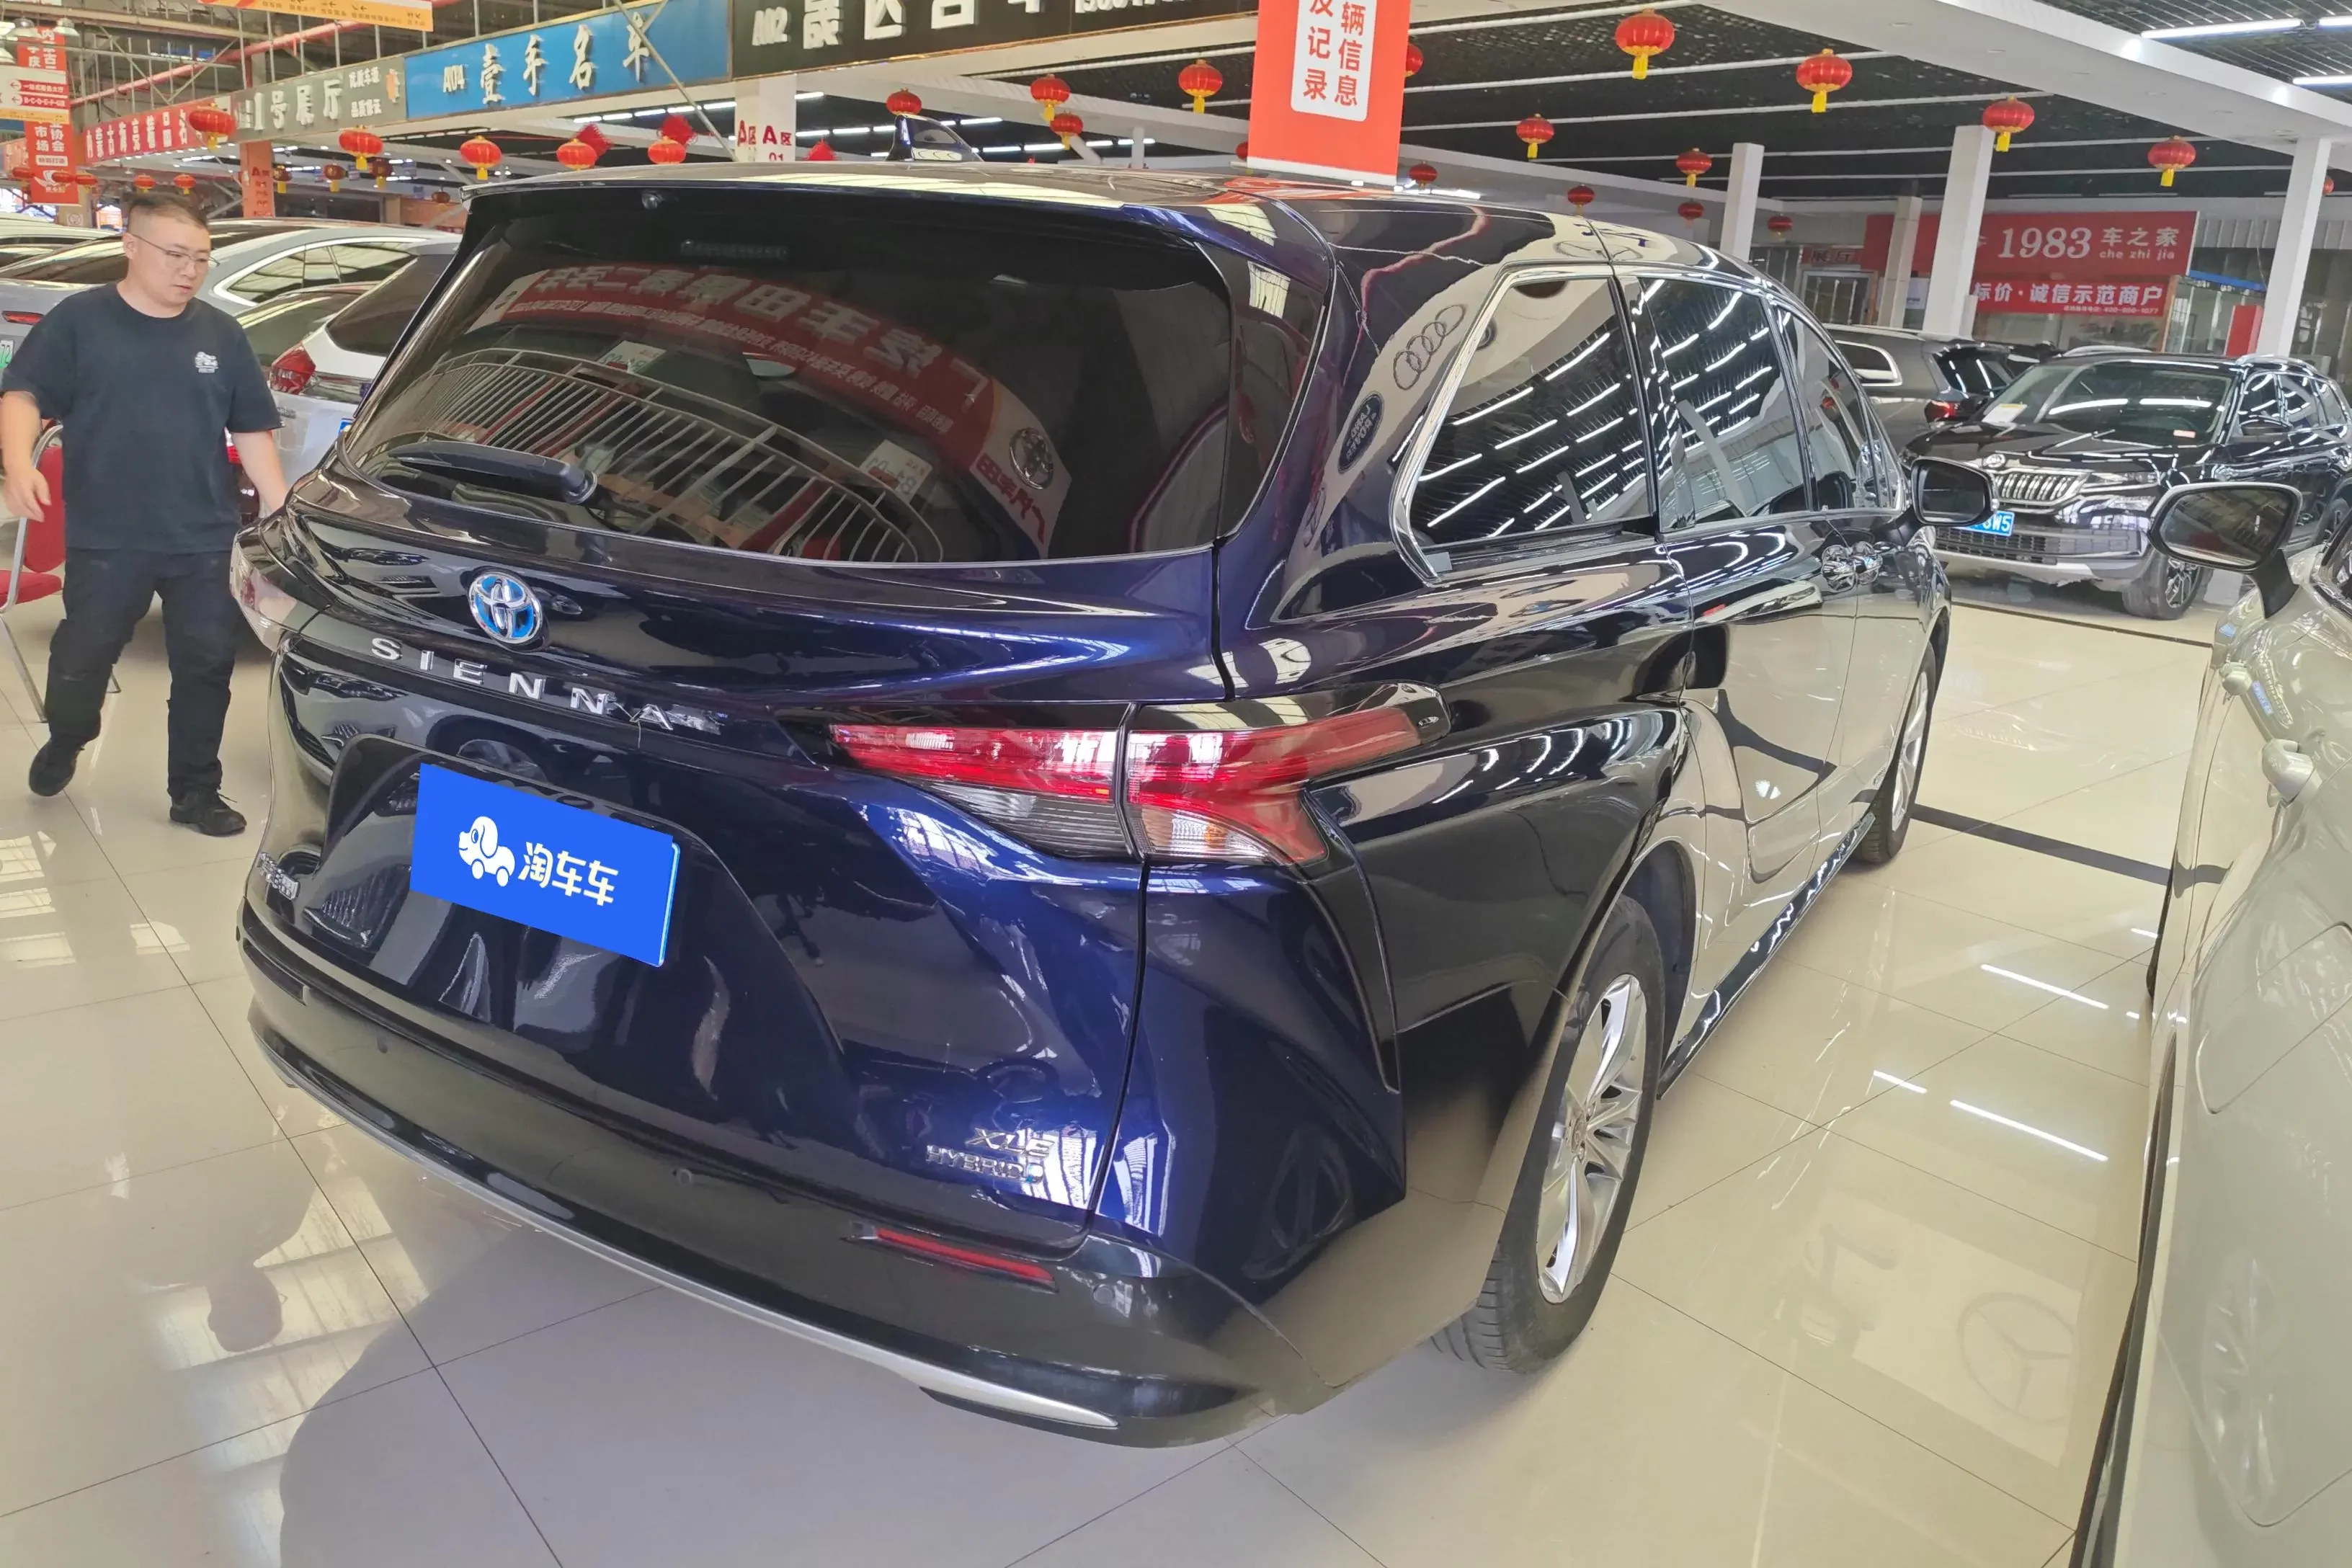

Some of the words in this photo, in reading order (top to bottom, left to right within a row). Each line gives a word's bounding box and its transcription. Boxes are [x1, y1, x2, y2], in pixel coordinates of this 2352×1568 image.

[762, 125, 792, 146] A区
[1997, 227, 2092, 259] 1983
[2101, 227, 2179, 247] 车之家
[2100, 249, 2124, 259] che
[2130, 249, 2151, 259] zhi
[2157, 249, 2175, 261] jia
[371, 638, 672, 730] SIENNA
[965, 1128, 1056, 1157] XLE
